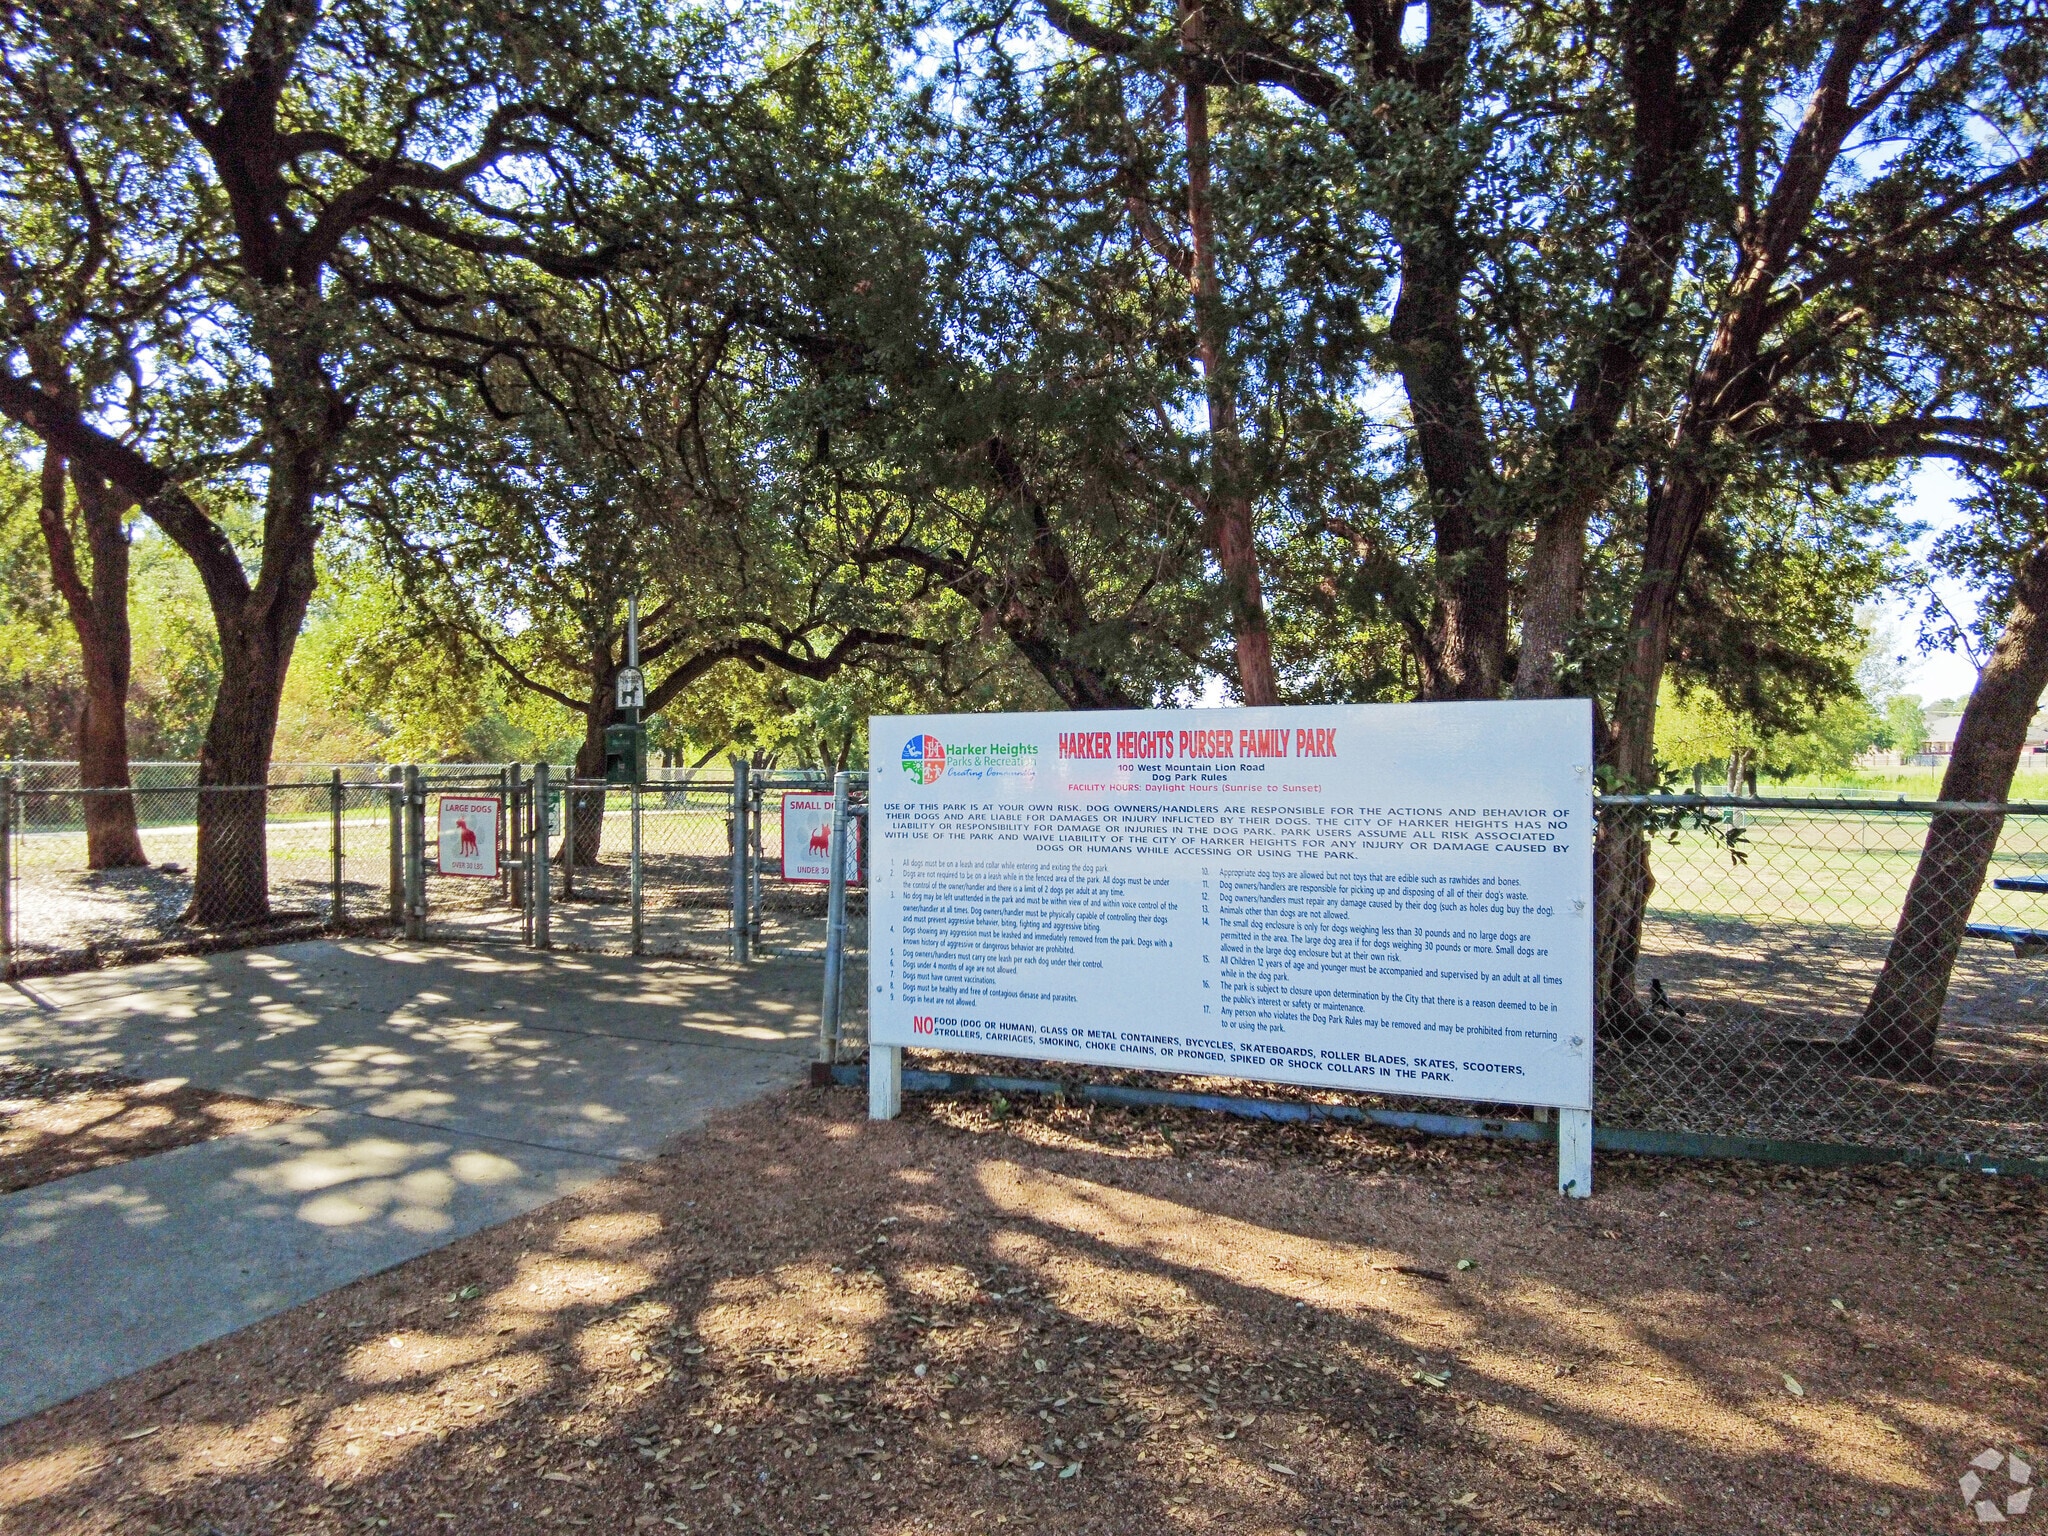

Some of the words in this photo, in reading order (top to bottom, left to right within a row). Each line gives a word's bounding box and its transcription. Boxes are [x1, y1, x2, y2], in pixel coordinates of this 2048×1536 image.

[946, 743, 987, 758] Harker
[990, 742, 1038, 757] Heights
[1058, 731, 1111, 759] HARKER
[1116, 730, 1174, 759] HEIGHTS
[1179, 729, 1233, 759] PURSER
[1239, 728, 1290, 758] FAMILY
[1296, 728, 1336, 757] PARK
[947, 757, 972, 767] Parks
[974, 756, 981, 766] &
[1137, 763, 1161, 771] West
[1165, 763, 1211, 771] Mountain
[1215, 763, 1236, 771] Lion
[1240, 763, 1264, 771] Road
[947, 767, 983, 780] Creating
[1152, 773, 1171, 782] Dog
[1174, 773, 1196, 781] Park
[1201, 773, 1227, 781] Rules
[1068, 783, 1105, 791] FACILITY
[1109, 783, 1141, 791] HOURS:
[1145, 783, 1185, 792] Daylight
[1221, 783, 1262, 792] (Sunrise
[1266, 784, 1278, 792] to
[1282, 784, 1321, 792] Sunset)
[445, 804, 469, 812] LARGE
[470, 805, 492, 813] DOGS
[790, 801, 821, 810] SMALL
[1086, 804, 1109, 812] DOG
[1113, 804, 1218, 813] OWNERS/HANDLERS
[1250, 806, 1324, 814] RESPONSIBLE
[1330, 806, 1353, 815] FOR
[1359, 807, 1381, 815] THE
[1387, 807, 1442, 816] ACTIONS
[1448, 808, 1476, 816] AND
[1482, 808, 1546, 817] BEHAVIOR
[1552, 809, 1569, 818] OF
[914, 812, 939, 820] DOGS
[990, 813, 1021, 821] LIABLE
[1049, 814, 1098, 822] DAMAGES
[1121, 815, 1157, 823] INJURY
[1162, 815, 1214, 823] INFLICTED
[1220, 816, 1233, 824] BY
[1238, 816, 1269, 824] THEIR
[1275, 817, 1310, 825] DOGS.
[1316, 817, 1337, 825] THE
[1343, 818, 1371, 826] CITY
[1377, 818, 1392, 826] OF
[1398, 819, 1448, 827] HARKER
[1455, 819, 1508, 828] HEIGHTS
[1514, 820, 1541, 829] HAS
[1548, 820, 1567, 829] NO
[912, 831, 928, 839] USE
[1059, 834, 1106, 842] LIABILITY
[1110, 835, 1123, 843] OF
[1129, 835, 1147, 843] THE
[1152, 836, 1176, 844] CITY
[1181, 836, 1195, 844] OF
[1200, 837, 1244, 845] HARKER
[1249, 838, 1296, 847] HEIGHTS
[1302, 839, 1325, 847] FOR
[1330, 840, 1356, 848] ANY
[1362, 841, 1403, 849] INJURY
[1409, 841, 1427, 850] OR
[1433, 842, 1489, 851] DAMAGE
[1495, 843, 1546, 853] CAUSED
[1552, 844, 1569, 853] BY
[1068, 844, 1082, 852] OR
[1087, 844, 1132, 853] HUMANS
[1136, 846, 1168, 854] WHILE
[1174, 846, 1231, 856] ACCESSING
[1236, 848, 1252, 856] OR
[1257, 849, 1291, 857] USING
[1296, 850, 1318, 858] THE
[1324, 851, 1357, 859] PARK.
[797, 866, 820, 874] UNDER
[821, 866, 830, 874] 30
[1219, 905, 1243, 915] Animals
[1244, 906, 1262, 916] other
[1263, 907, 1278, 916] than
[1279, 908, 1295, 918] dogs
[1297, 910, 1308, 918] are
[1309, 910, 1321, 918] not
[902, 970, 916, 980] Dogs
[916, 972, 929, 980] must
[930, 972, 943, 981] have
[944, 974, 962, 982] current
[913, 1015, 933, 1035] NO
[1221, 1019, 1228, 1028] to
[1238, 1020, 1255, 1031] using
[1257, 1021, 1267, 1031] the
[934, 1016, 957, 1026] FOOD
[960, 1018, 981, 1029] (DOG
[984, 1020, 995, 1029] OR
[999, 1022, 1036, 1033] HUMAN),
[1040, 1025, 1067, 1035] GLASS
[1071, 1027, 1083, 1037] OR
[1087, 1029, 1116, 1039] METAL
[1120, 1032, 1181, 1045] CONTAINERS,
[1185, 1038, 1235, 1051] BYCYCLES,
[1240, 1042, 1316, 1058] SKATEBOARDS,
[1320, 1049, 1360, 1061] ROLLER
[1364, 1053, 1408, 1066] BLADES,
[1413, 1057, 1457, 1070] SKATES,
[1462, 1061, 1525, 1075] SCOOTERS,
[934, 1027, 982, 1039] STROLLERS,
[985, 1032, 1035, 1044] CARRIAGES,
[1039, 1036, 1081, 1048] SMOKING,
[1085, 1040, 1115, 1051] CHOKE
[1119, 1043, 1156, 1055] CHAINS,
[1160, 1047, 1173, 1056] OR
[1177, 1049, 1225, 1062] PRONGED,
[1230, 1053, 1265, 1065] SPIKED
[1269, 1057, 1283, 1066] OR
[1287, 1059, 1322, 1070] SHOCK
[1327, 1062, 1375, 1075] COLLARS
[1379, 1067, 1390, 1076] IN
[1395, 1068, 1416, 1079] THE
[1421, 1070, 1453, 1082] PARK.
